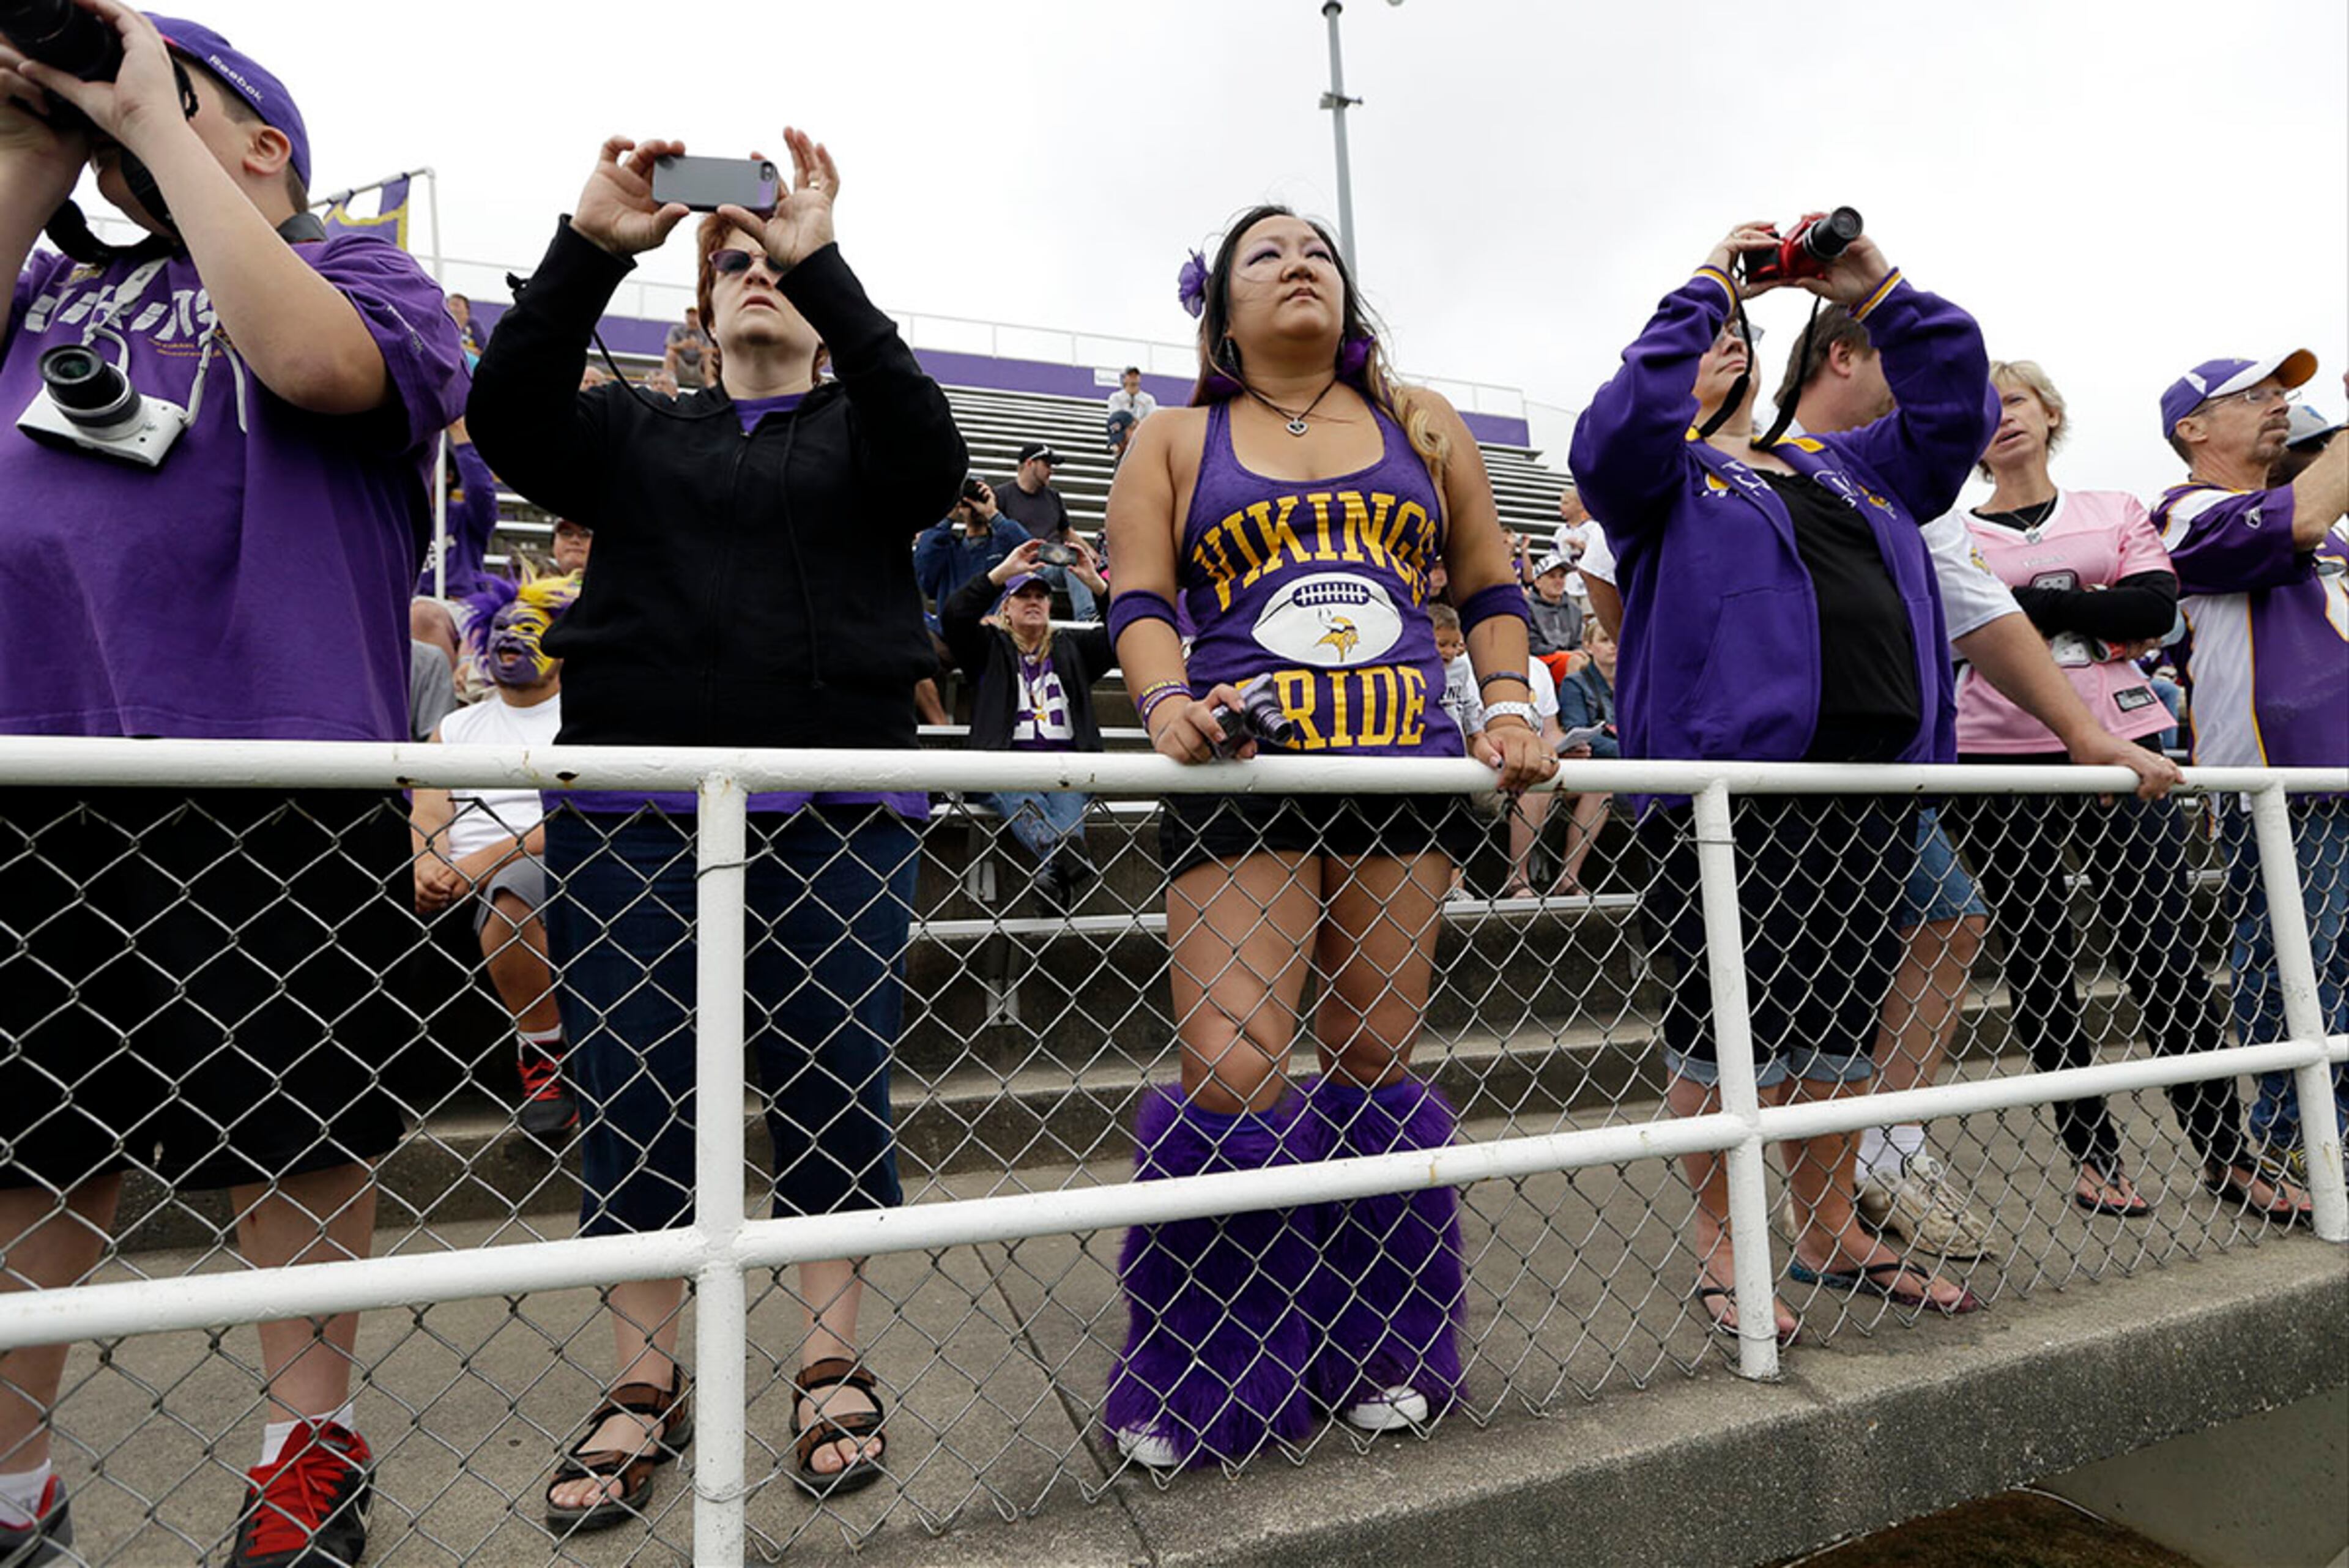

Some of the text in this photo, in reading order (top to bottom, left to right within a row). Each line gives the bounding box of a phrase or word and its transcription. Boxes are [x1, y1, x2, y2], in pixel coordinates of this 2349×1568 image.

[209, 54, 264, 103] Reebok
[1193, 491, 1436, 612] VIKINGS
[1235, 666, 1427, 750] RIDE
